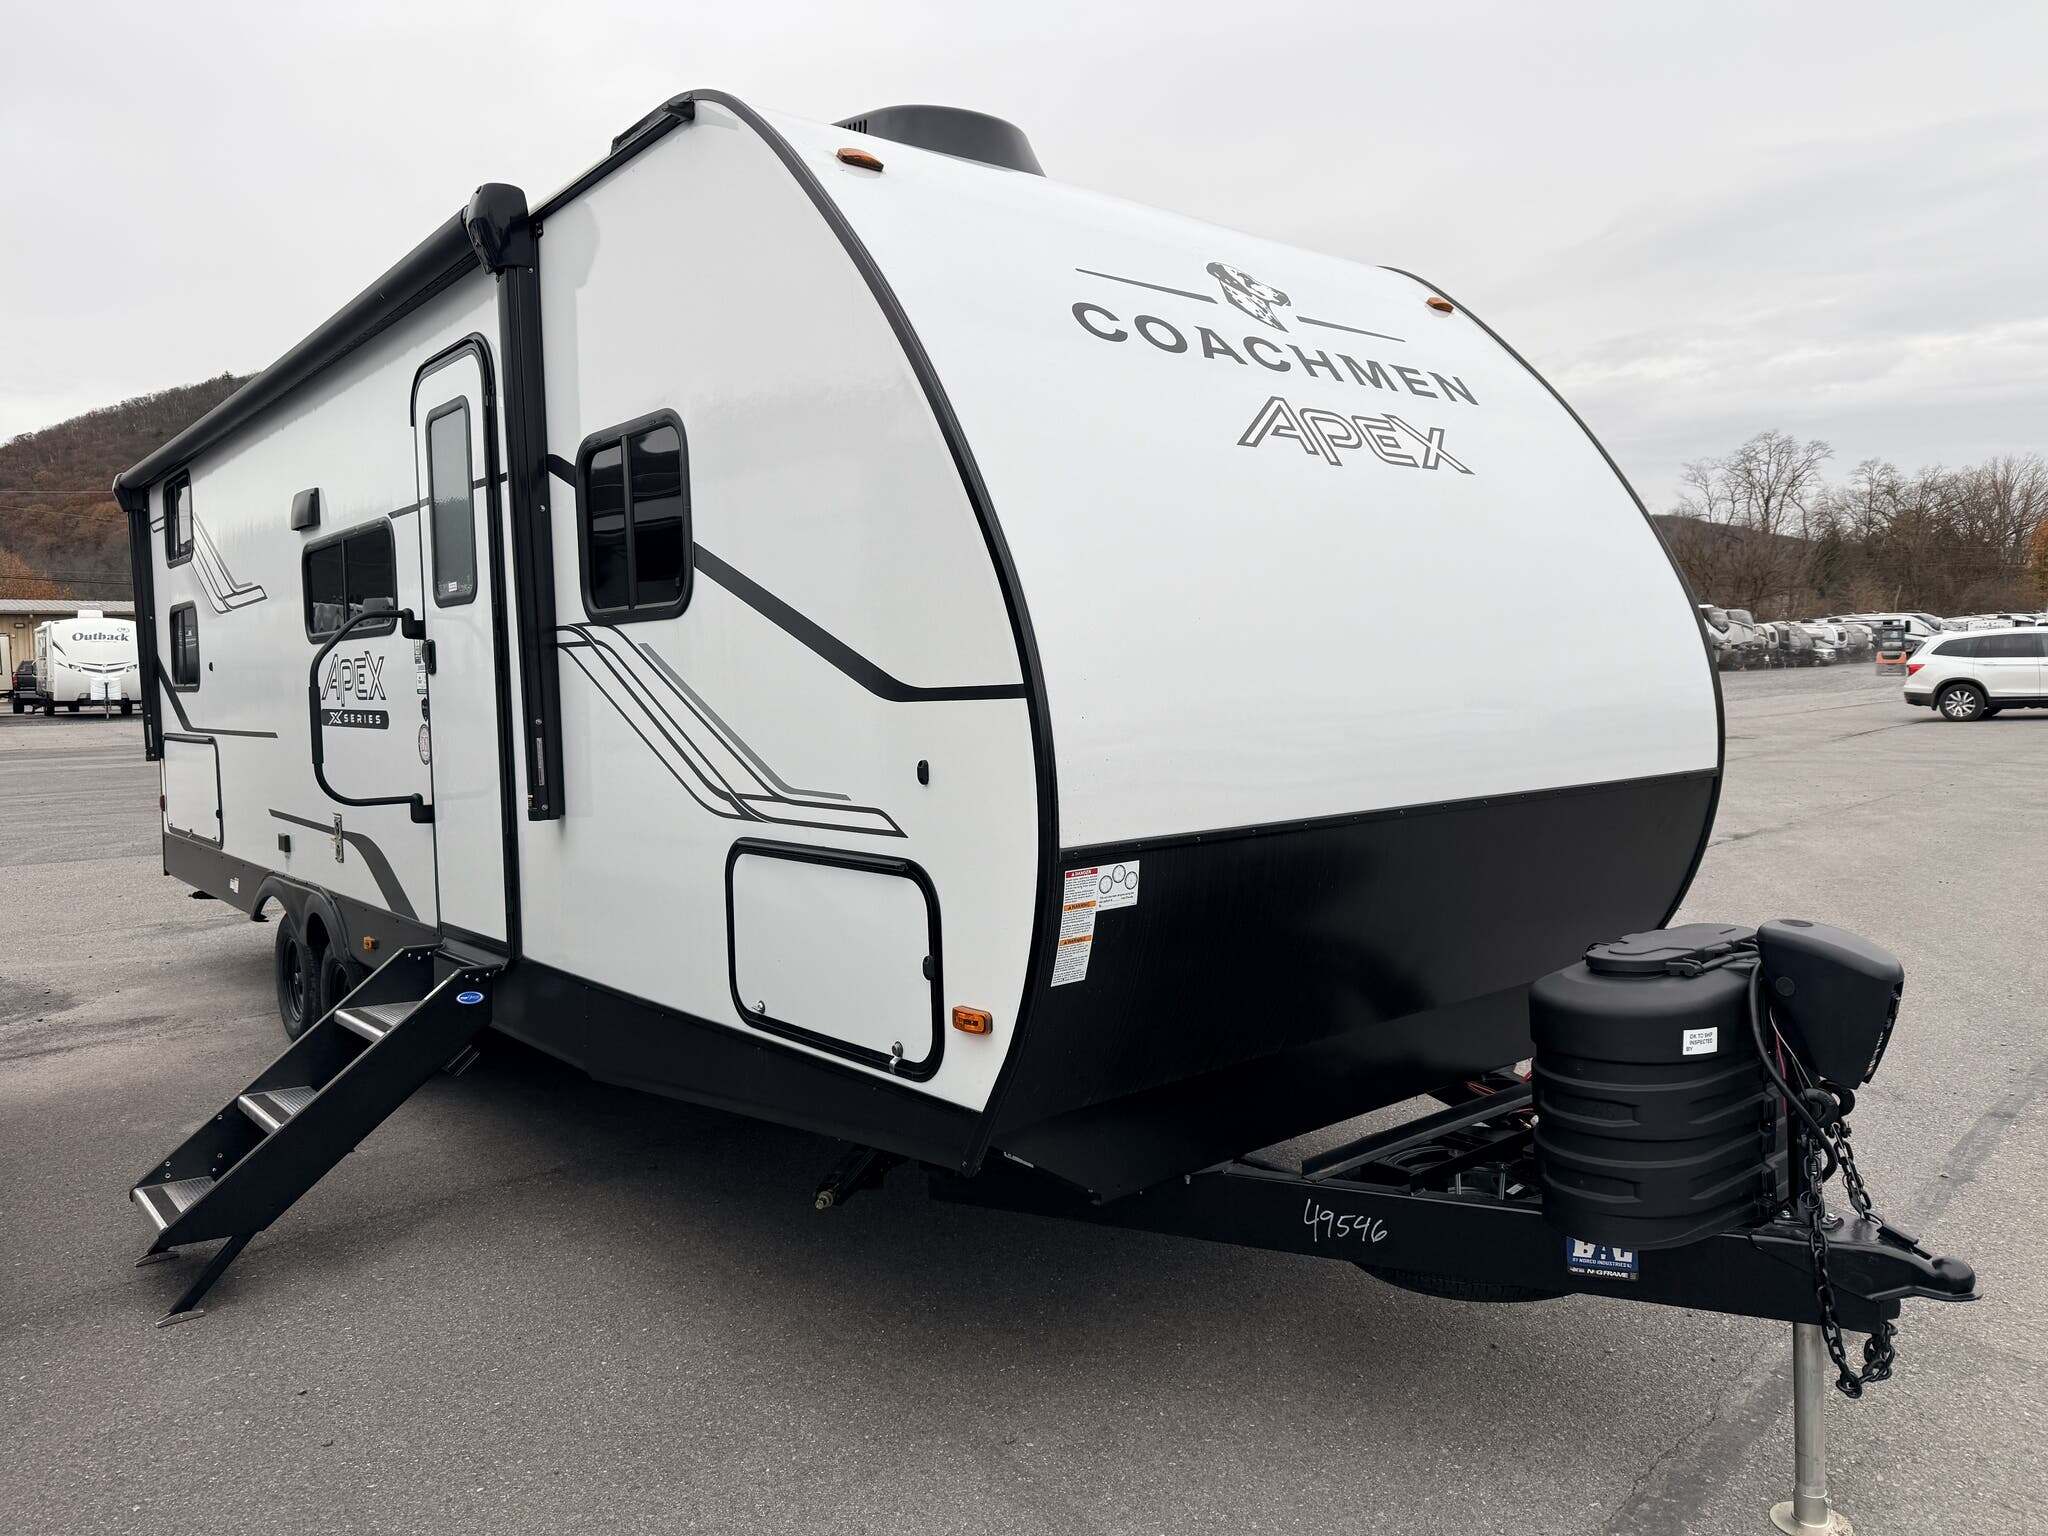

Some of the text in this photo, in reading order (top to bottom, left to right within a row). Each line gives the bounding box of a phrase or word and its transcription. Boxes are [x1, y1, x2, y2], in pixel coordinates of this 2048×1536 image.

[1072, 302, 1479, 405] COACHMEN
[1237, 396, 1475, 475] APEX
[72, 632, 128, 641] Outback
[322, 650, 386, 707] APEX
[344, 713, 381, 724] SERIES
[1304, 1198, 1388, 1242] 49596
[1597, 1259, 1627, 1268] INDUSTRIES
